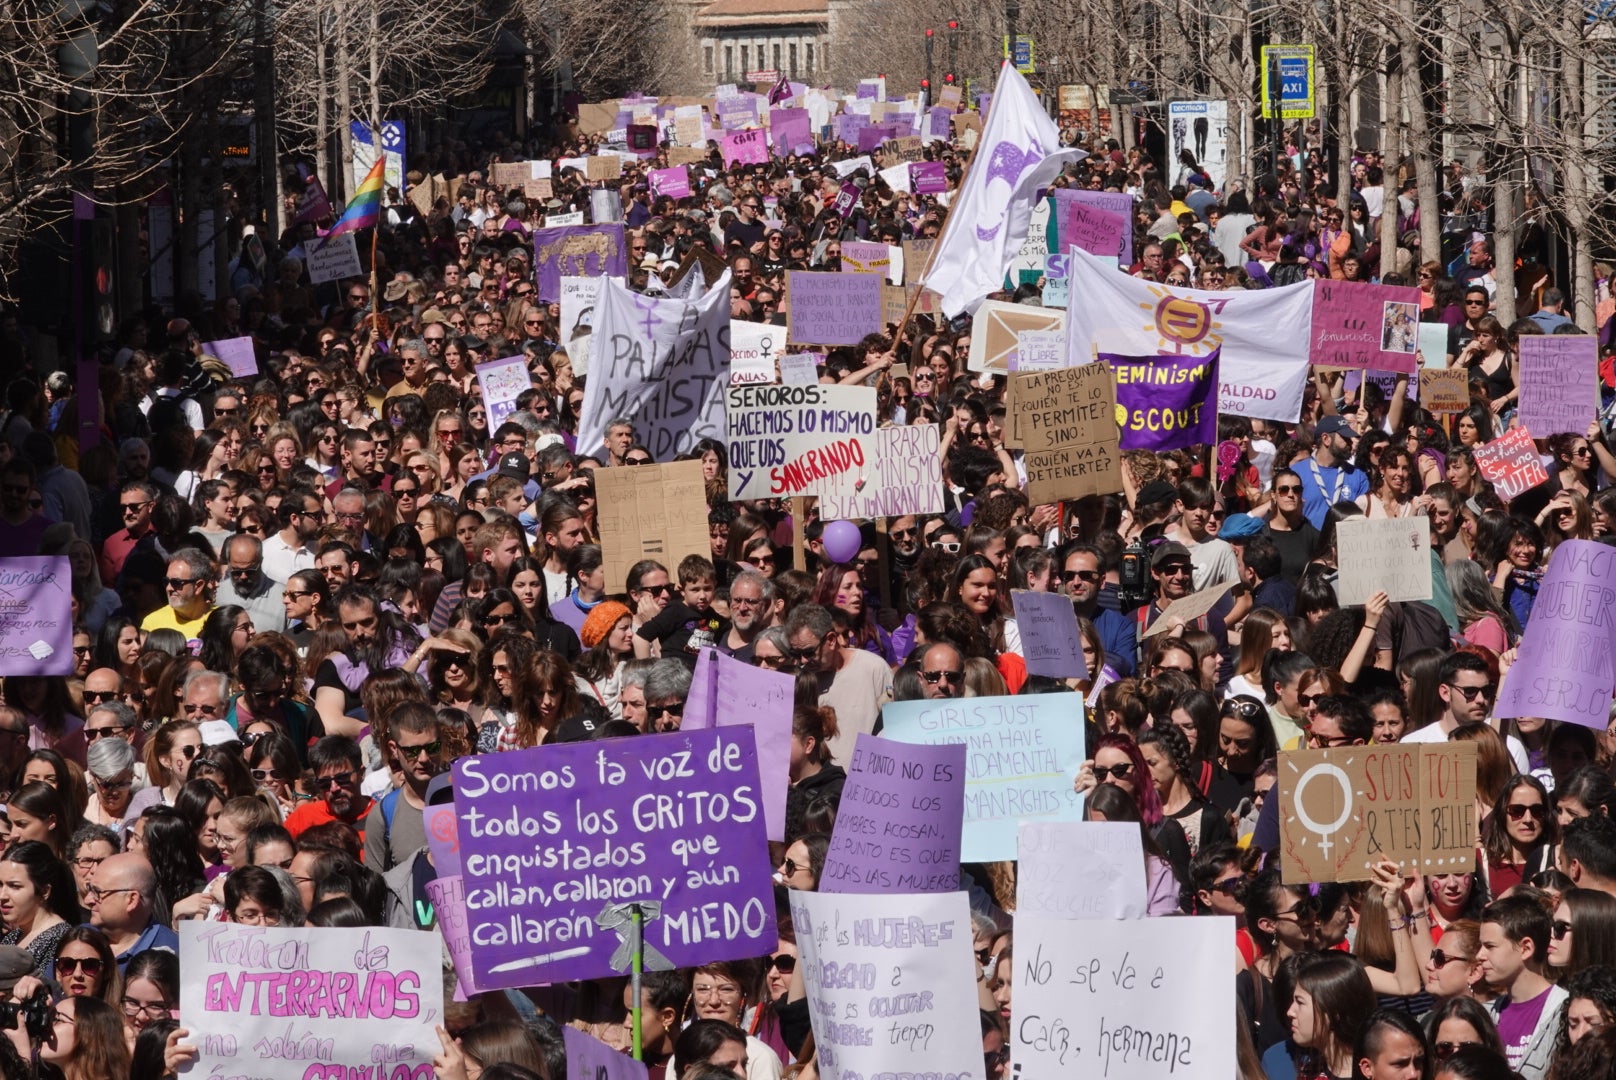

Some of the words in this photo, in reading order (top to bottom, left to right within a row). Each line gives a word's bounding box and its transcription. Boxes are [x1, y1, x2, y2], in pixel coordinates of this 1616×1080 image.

[1282, 83, 1302, 93] AXI
[883, 141, 899, 157] NO
[1317, 329, 1381, 350] feminista
[731, 372, 768, 383] CALLAS
[1027, 375, 1042, 390] LA
[1043, 362, 1107, 386] PREGUNTA
[1109, 362, 1211, 385] EMiNiSM
[729, 386, 828, 408] SEÑOROS:
[1047, 382, 1061, 395] NO
[1069, 393, 1080, 404] TE
[1088, 387, 1101, 400] LO
[1219, 383, 1277, 401] ALDAD
[728, 408, 795, 437] HACEMOS
[798, 409, 816, 434] LO
[820, 410, 873, 435] MISMO
[1130, 402, 1204, 431] SCOUT
[1045, 425, 1085, 447] SINO:
[729, 440, 753, 470] QUE
[757, 438, 786, 467] UDS
[734, 470, 753, 497] Y
[769, 437, 865, 495] SANGRANDO
[1076, 447, 1093, 460] VA
[1098, 447, 1108, 456] A
[1487, 462, 1508, 480] Ser
[1511, 451, 1534, 469] una
[1028, 458, 1112, 483] DETENERTE?
[1493, 459, 1547, 498] MUJER
[820, 495, 838, 521] ES
[840, 493, 861, 519] LA
[863, 484, 945, 518] IGNORANCIA
[918, 707, 987, 730] GIRLS
[992, 704, 1039, 726] JUST
[1000, 728, 1043, 749] HAVE
[459, 759, 577, 798] Somos
[640, 748, 696, 783] voz
[708, 735, 743, 774] de
[852, 750, 863, 773] EL
[866, 751, 895, 776] PUNTO
[902, 761, 924, 781] NO
[933, 763, 953, 782] ES
[863, 784, 900, 808] TODOS
[912, 795, 941, 811] LOS
[1006, 787, 1061, 814] RIGHTS
[461, 805, 562, 838] todos
[576, 799, 619, 836] los
[883, 821, 946, 840] ACOSAN,
[1366, 809, 1383, 855] &
[1384, 806, 1422, 851] T'ES
[1430, 803, 1474, 851] BELLE
[466, 839, 647, 884] enquistados
[671, 834, 721, 866] que
[830, 836, 842, 851] EL
[844, 837, 882, 858] PUNTO
[890, 846, 911, 864] ES
[918, 848, 952, 864] QUE
[661, 876, 677, 900] y
[687, 860, 740, 890] aún
[826, 858, 861, 884] TODAS
[865, 867, 891, 888] LAS
[898, 871, 960, 891] MUJERES
[1020, 862, 1065, 883] VOZ
[472, 908, 593, 947] callarán
[854, 915, 955, 948] MUJERES
[353, 930, 390, 970] de
[818, 958, 877, 991] DERECHO
[891, 965, 902, 986] a
[1069, 958, 1100, 993] se
[1150, 966, 1164, 989] a
[868, 990, 934, 1018] OCULTAR
[204, 1032, 237, 1058] no
[371, 1042, 415, 1066] que
[888, 1021, 934, 1051] tienen
